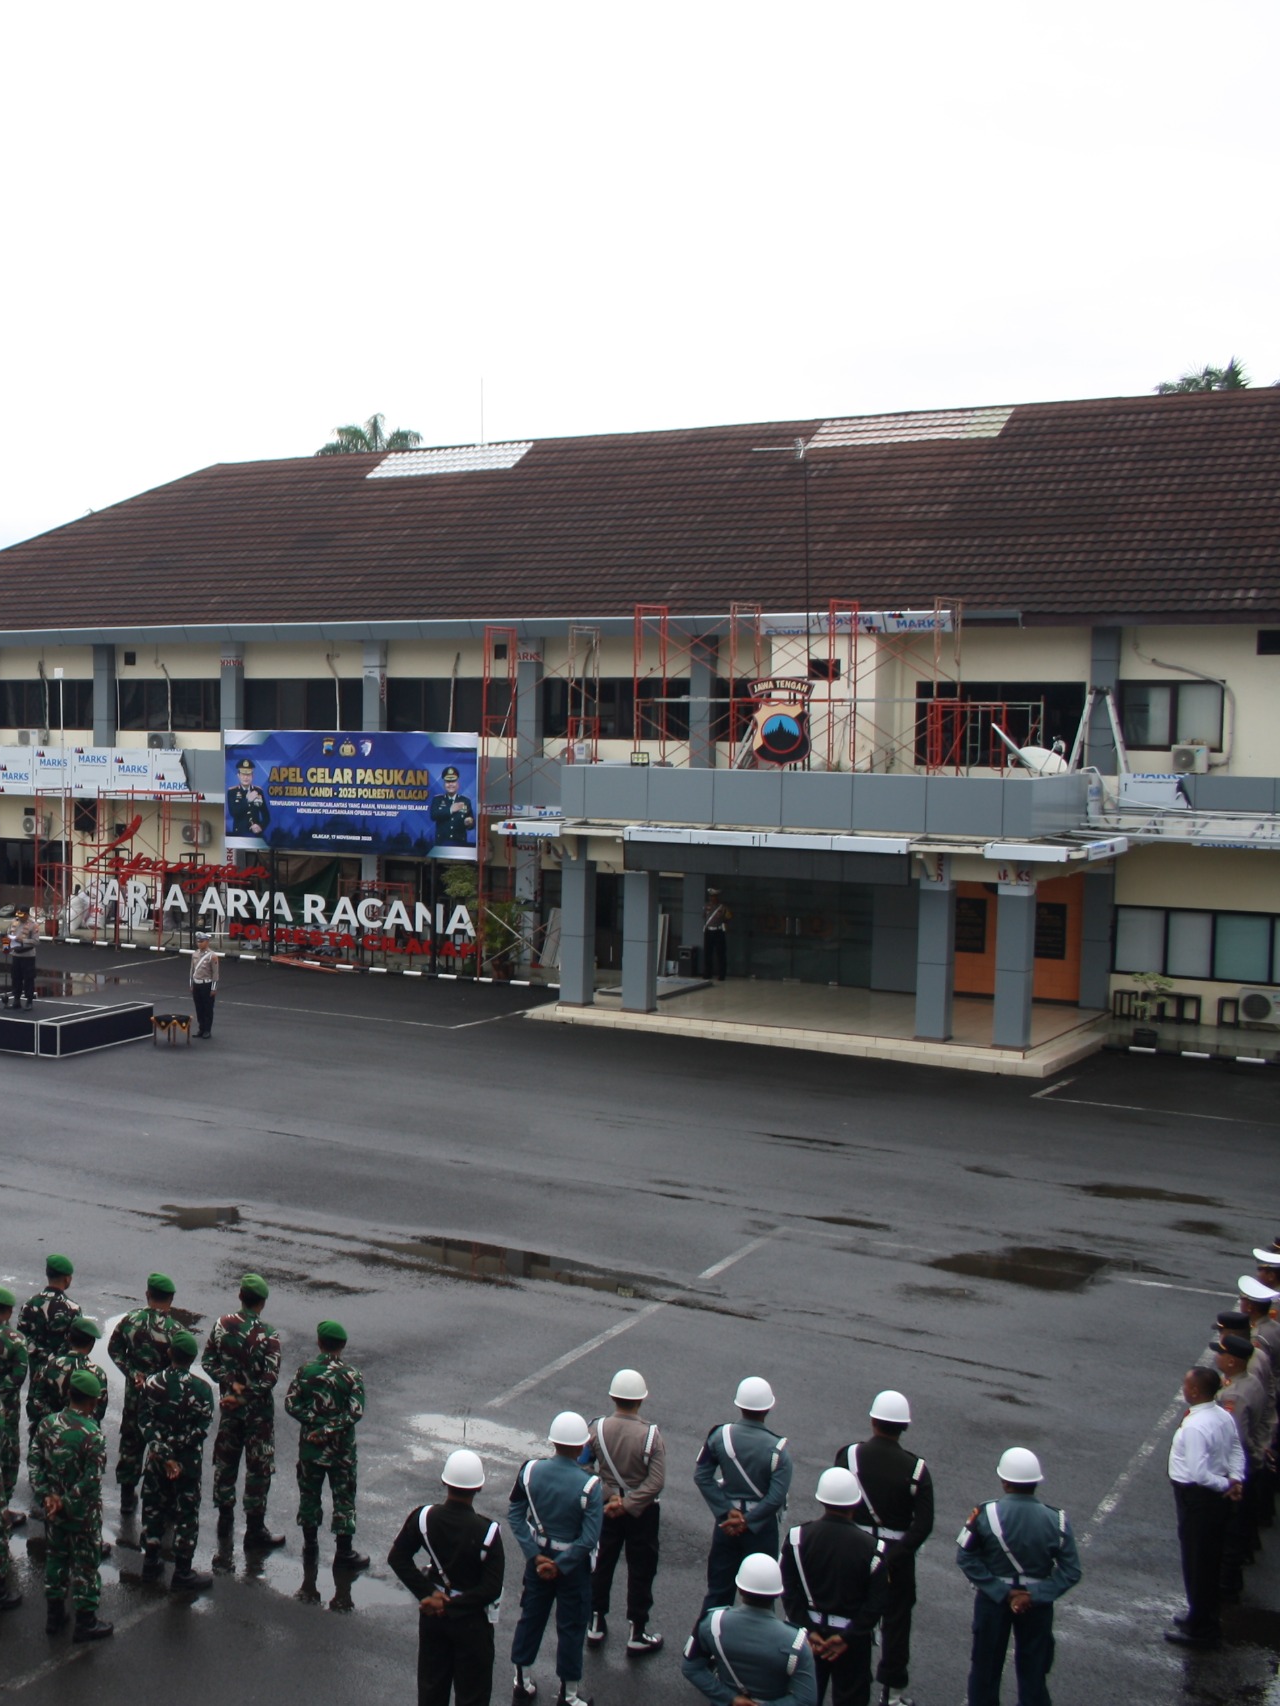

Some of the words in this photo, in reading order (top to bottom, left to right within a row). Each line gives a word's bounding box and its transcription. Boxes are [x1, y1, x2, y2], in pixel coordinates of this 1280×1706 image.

[896, 618, 945, 630] MARKS
[753, 681, 774, 693] JAWA
[776, 680, 808, 692] TENGAH
[40, 759, 68, 767] MARKS
[78, 755, 107, 763] MARKS
[2, 772, 29, 780] MARKS
[118, 765, 148, 774] MARKS
[269, 767, 304, 783] APEL
[307, 767, 353, 784] GELAR
[356, 768, 428, 786] PASUKAN
[269, 786, 283, 796] OPS
[285, 786, 308, 797] ZEBRA
[309, 787, 333, 797] CANDI
[338, 788, 356, 798] 2025
[357, 788, 395, 799] POLRESTA
[396, 789, 428, 800] CILACAP
[78, 814, 272, 893] Lapangan
[198, 886, 294, 922] ARYA
[303, 893, 477, 937] RACANA
[228, 922, 356, 951] POLRESTA
[361, 933, 477, 959] CILACAP
